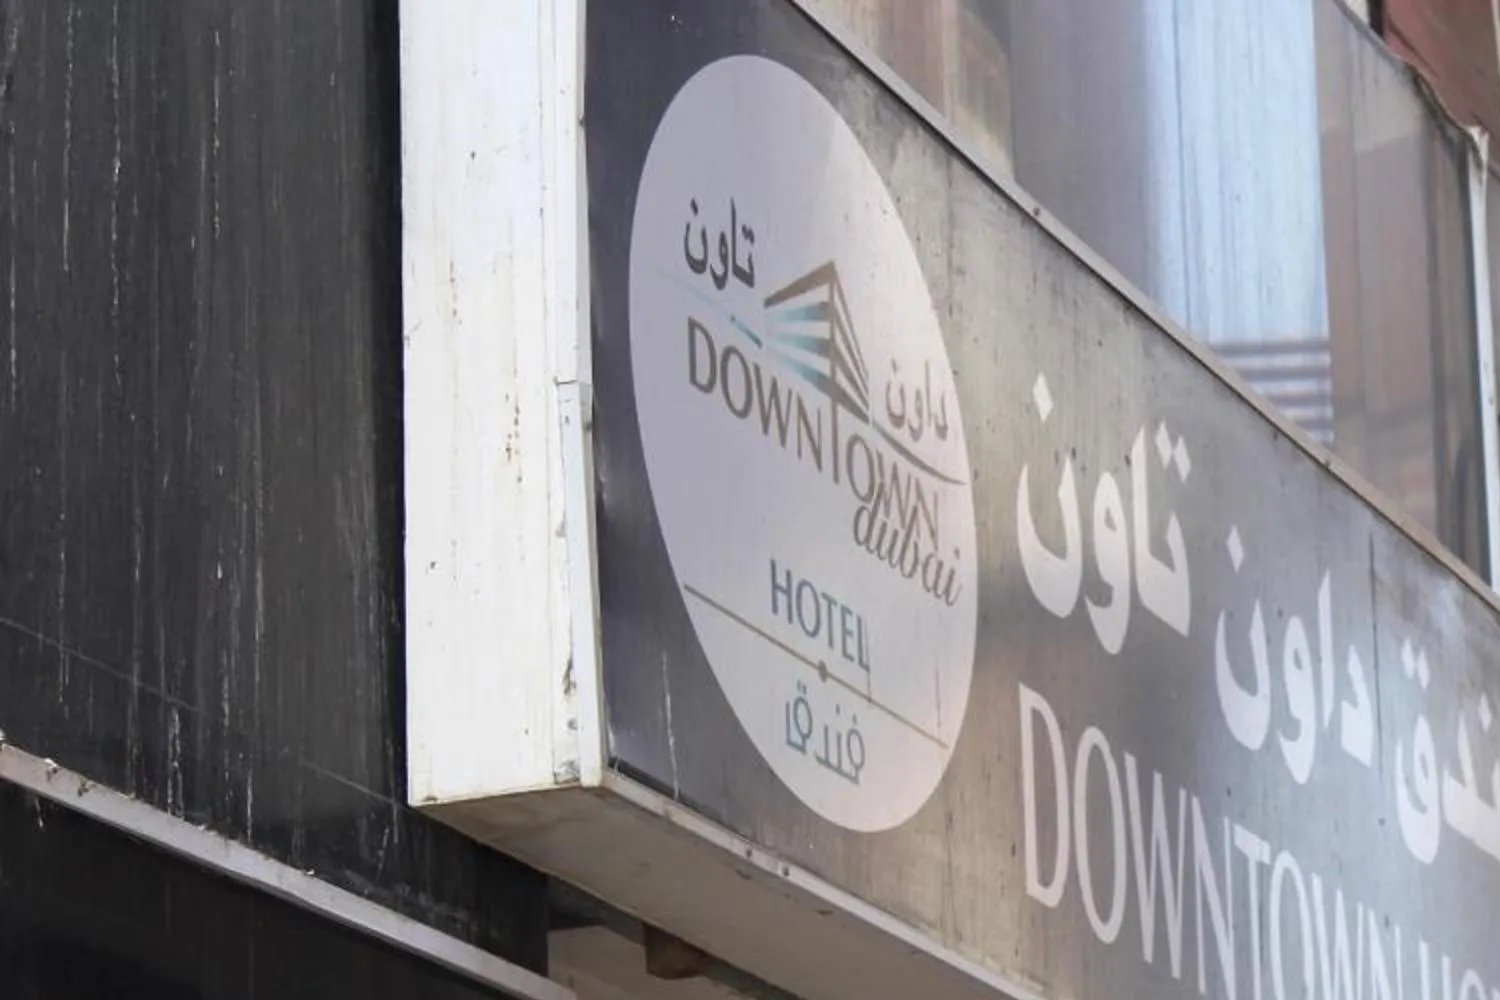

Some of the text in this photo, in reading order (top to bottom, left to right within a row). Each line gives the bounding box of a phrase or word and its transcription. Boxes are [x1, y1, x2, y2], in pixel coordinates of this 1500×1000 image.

[684, 198, 949, 443] داون تاون
[687, 316, 939, 552] DOWNTOWN
[770, 558, 871, 673] HOTEL
[853, 483, 964, 607] dubai
[1016, 373, 1192, 655] تاون
[784, 679, 866, 785] فندق
[1214, 524, 1373, 784] داون
